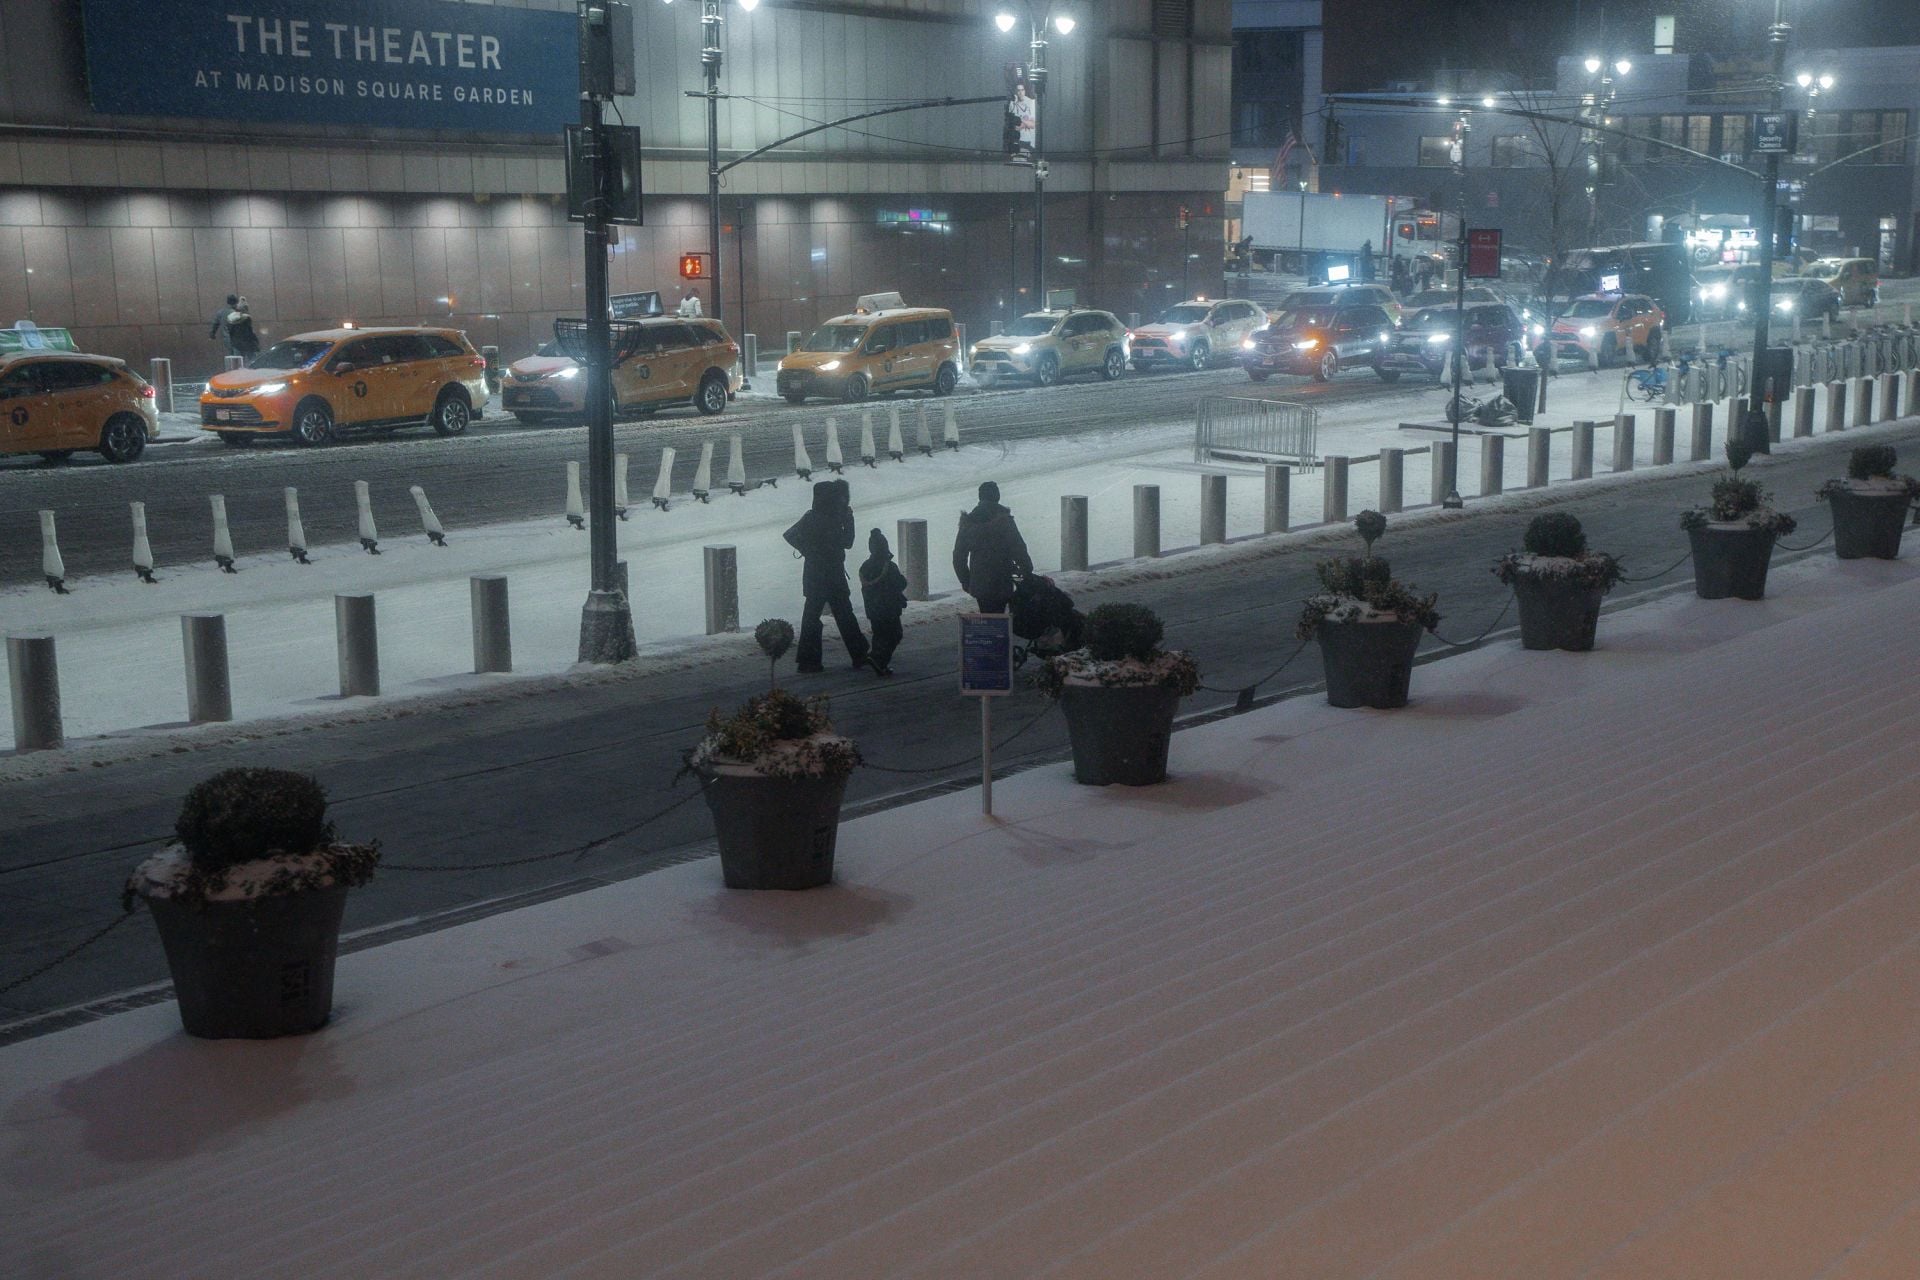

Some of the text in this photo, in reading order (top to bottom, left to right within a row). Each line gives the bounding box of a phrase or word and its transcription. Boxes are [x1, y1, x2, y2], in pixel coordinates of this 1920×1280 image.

[226, 14, 502, 71] THE THEATER
[194, 70, 534, 106] AT MADISON SQUARE GARDEN
[1758, 135, 1783, 143] Security
